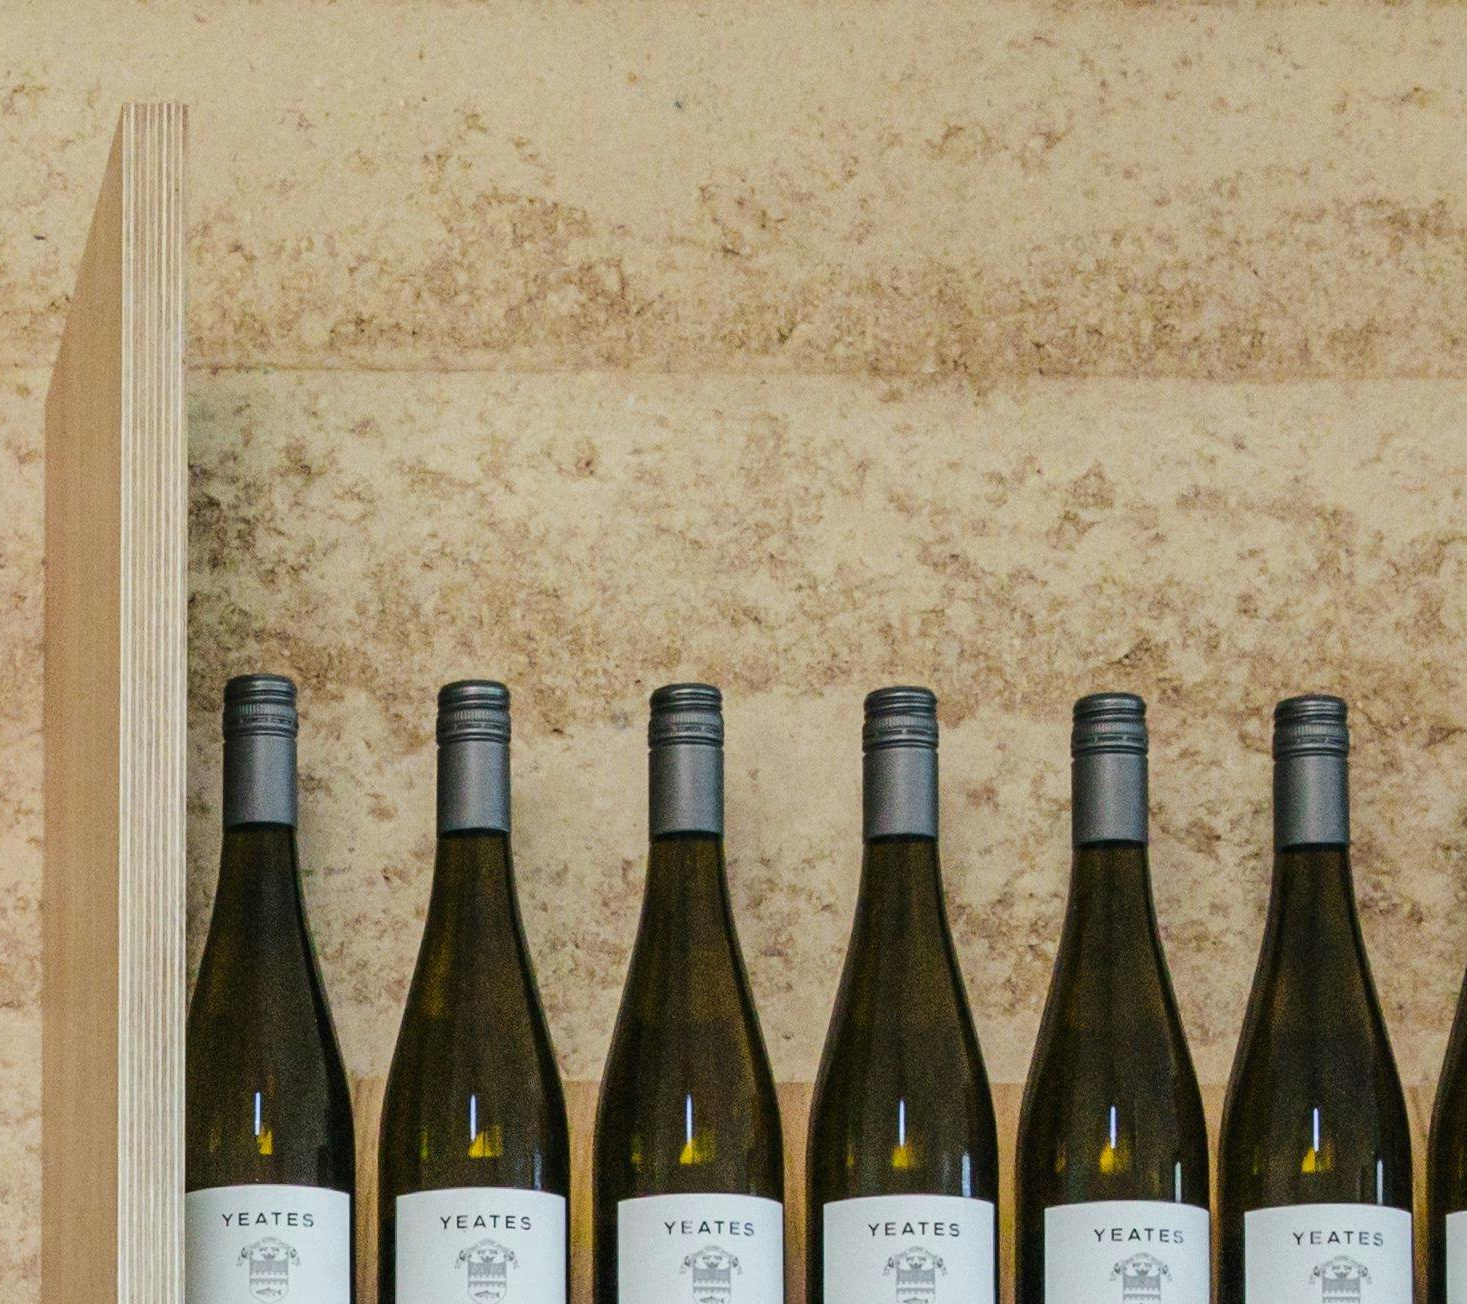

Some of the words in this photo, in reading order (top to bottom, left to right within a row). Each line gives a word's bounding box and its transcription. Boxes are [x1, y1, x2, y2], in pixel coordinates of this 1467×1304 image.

[222, 1212, 313, 1227] YEATES
[440, 1215, 531, 1230] YEATES
[665, 1221, 755, 1236] YEATES
[868, 1222, 960, 1237] YEATES
[1095, 1228, 1185, 1243] YEATES
[1294, 1231, 1384, 1246] YEATES
